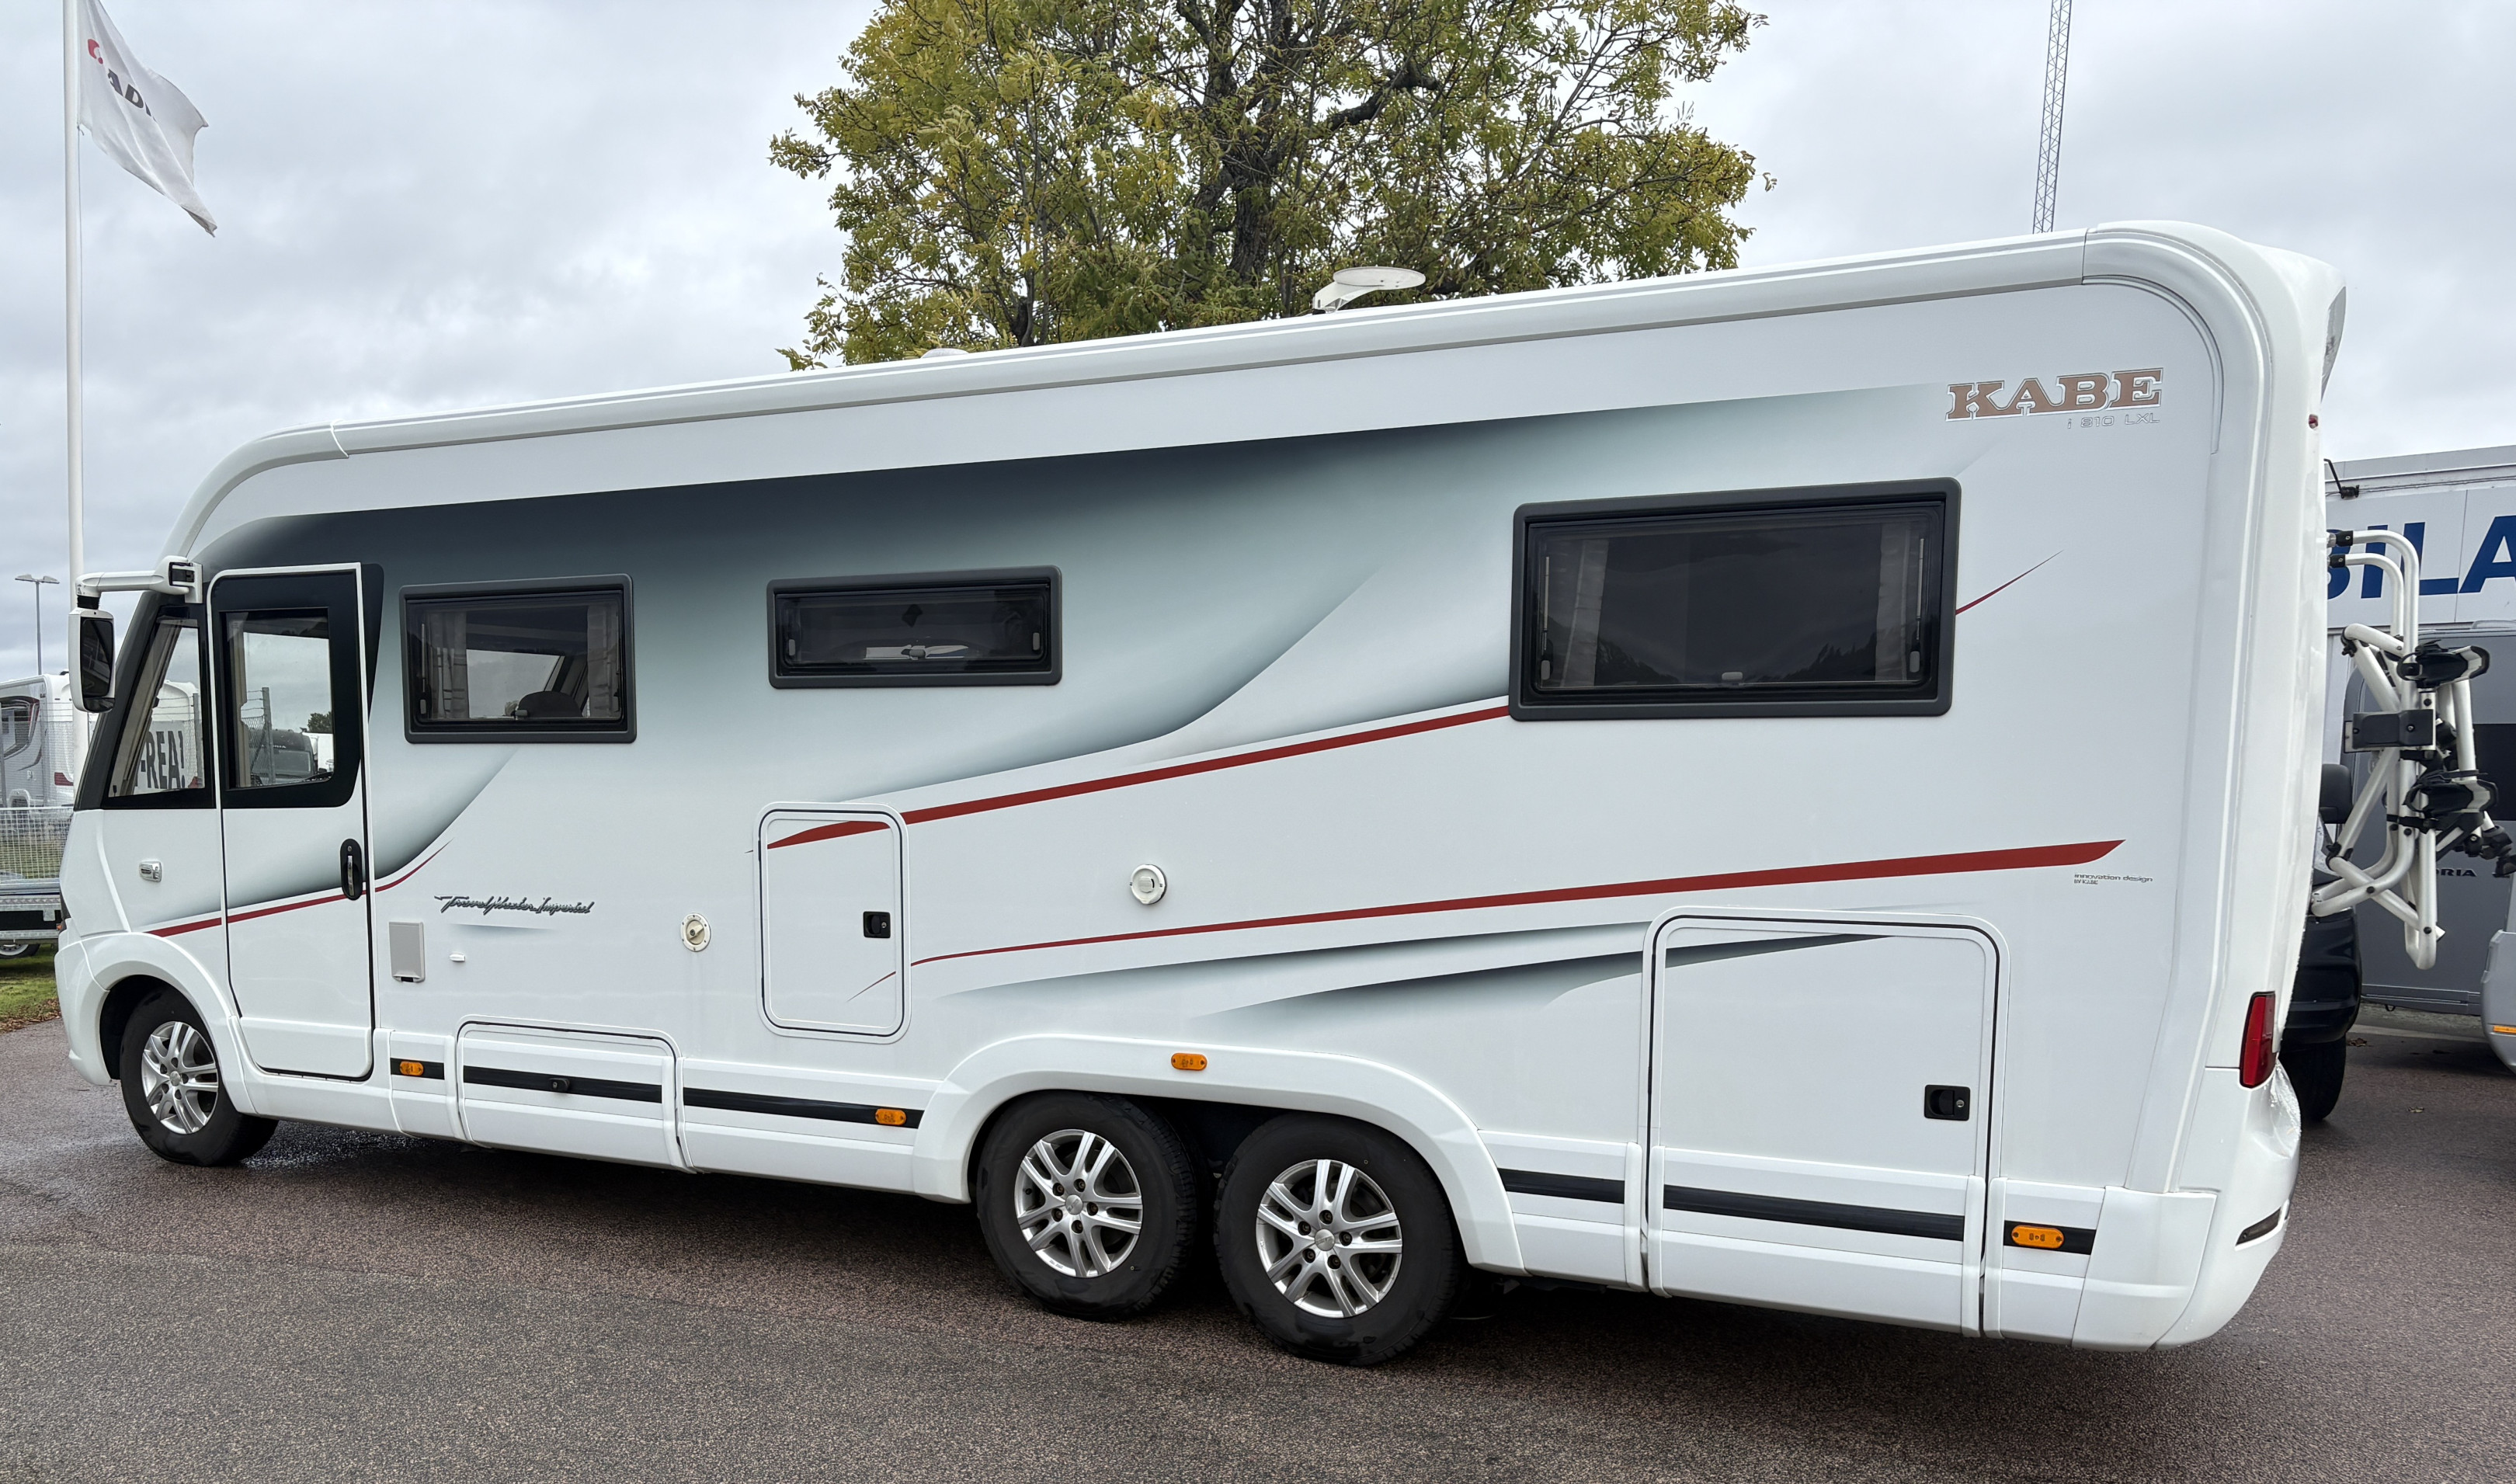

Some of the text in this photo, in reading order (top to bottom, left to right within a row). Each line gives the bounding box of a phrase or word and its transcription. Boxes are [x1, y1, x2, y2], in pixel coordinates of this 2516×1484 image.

[1945, 367, 2164, 422] KABE
[2080, 415, 2115, 428] 810
[2125, 412, 2160, 426] LXL
[2122, 874, 2153, 883] design
